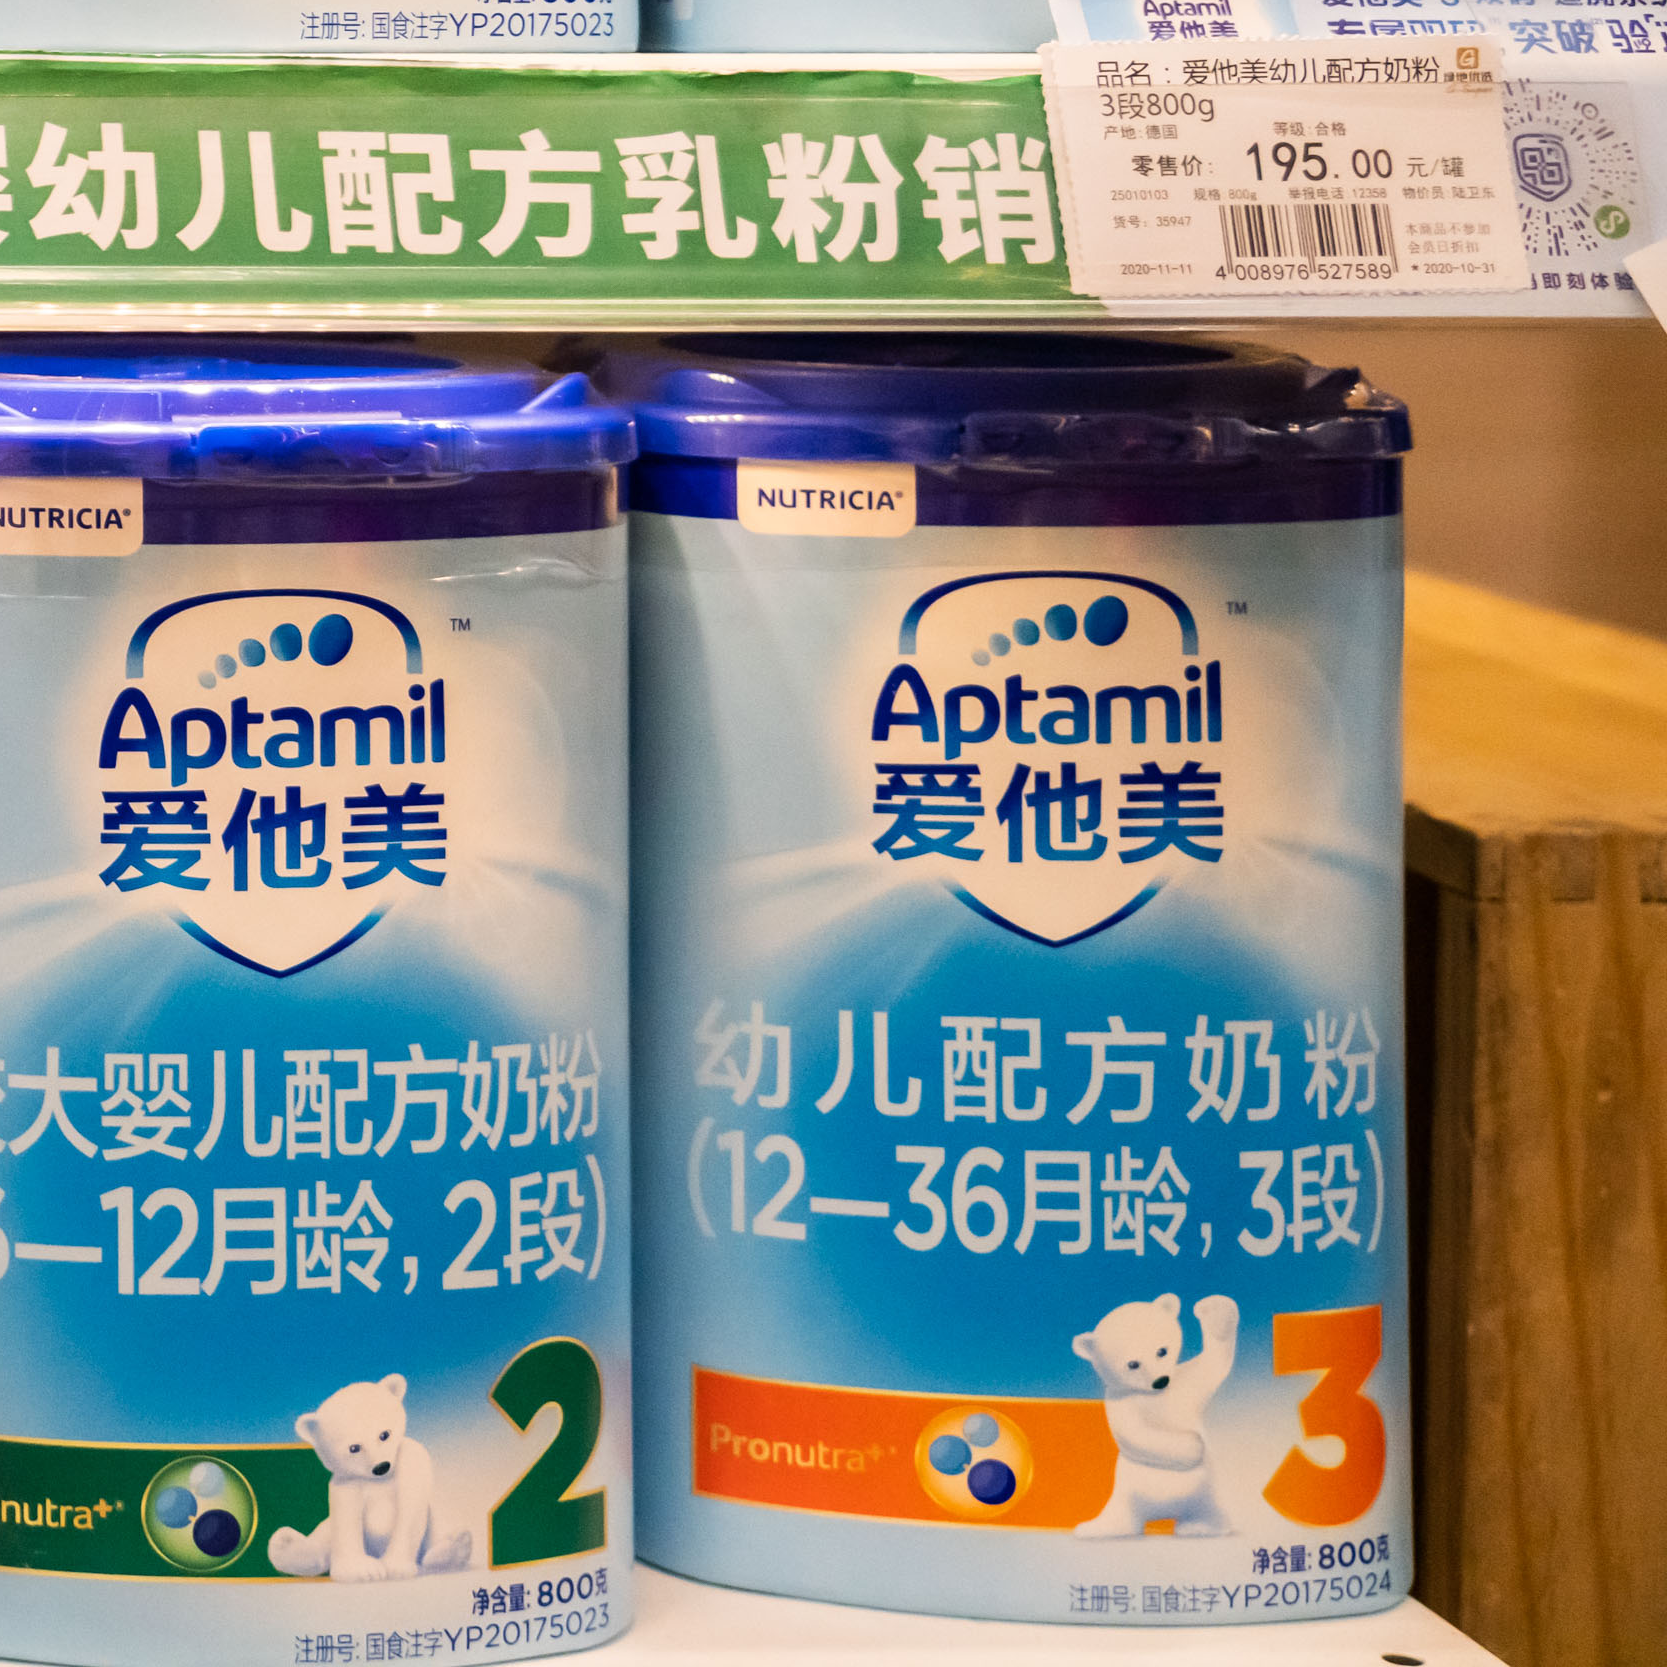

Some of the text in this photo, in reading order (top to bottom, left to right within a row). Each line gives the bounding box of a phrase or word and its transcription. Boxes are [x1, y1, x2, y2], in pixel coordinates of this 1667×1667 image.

[1100, 92, 1216, 123] 3段800g
[1234, 263, 1393, 281] 008976 527589
[98, 677, 446, 789] Aptamil
[870, 658, 1223, 761] Aptamil
[98, 782, 448, 894] 爱他美
[870, 760, 1225, 866] 爱他美
[692, 998, 1382, 1125] 幼儿配方奶粉
[486, 1334, 609, 1572] 2
[1261, 1301, 1388, 1529] 3
[1316, 1532, 1391, 1571] 800克
